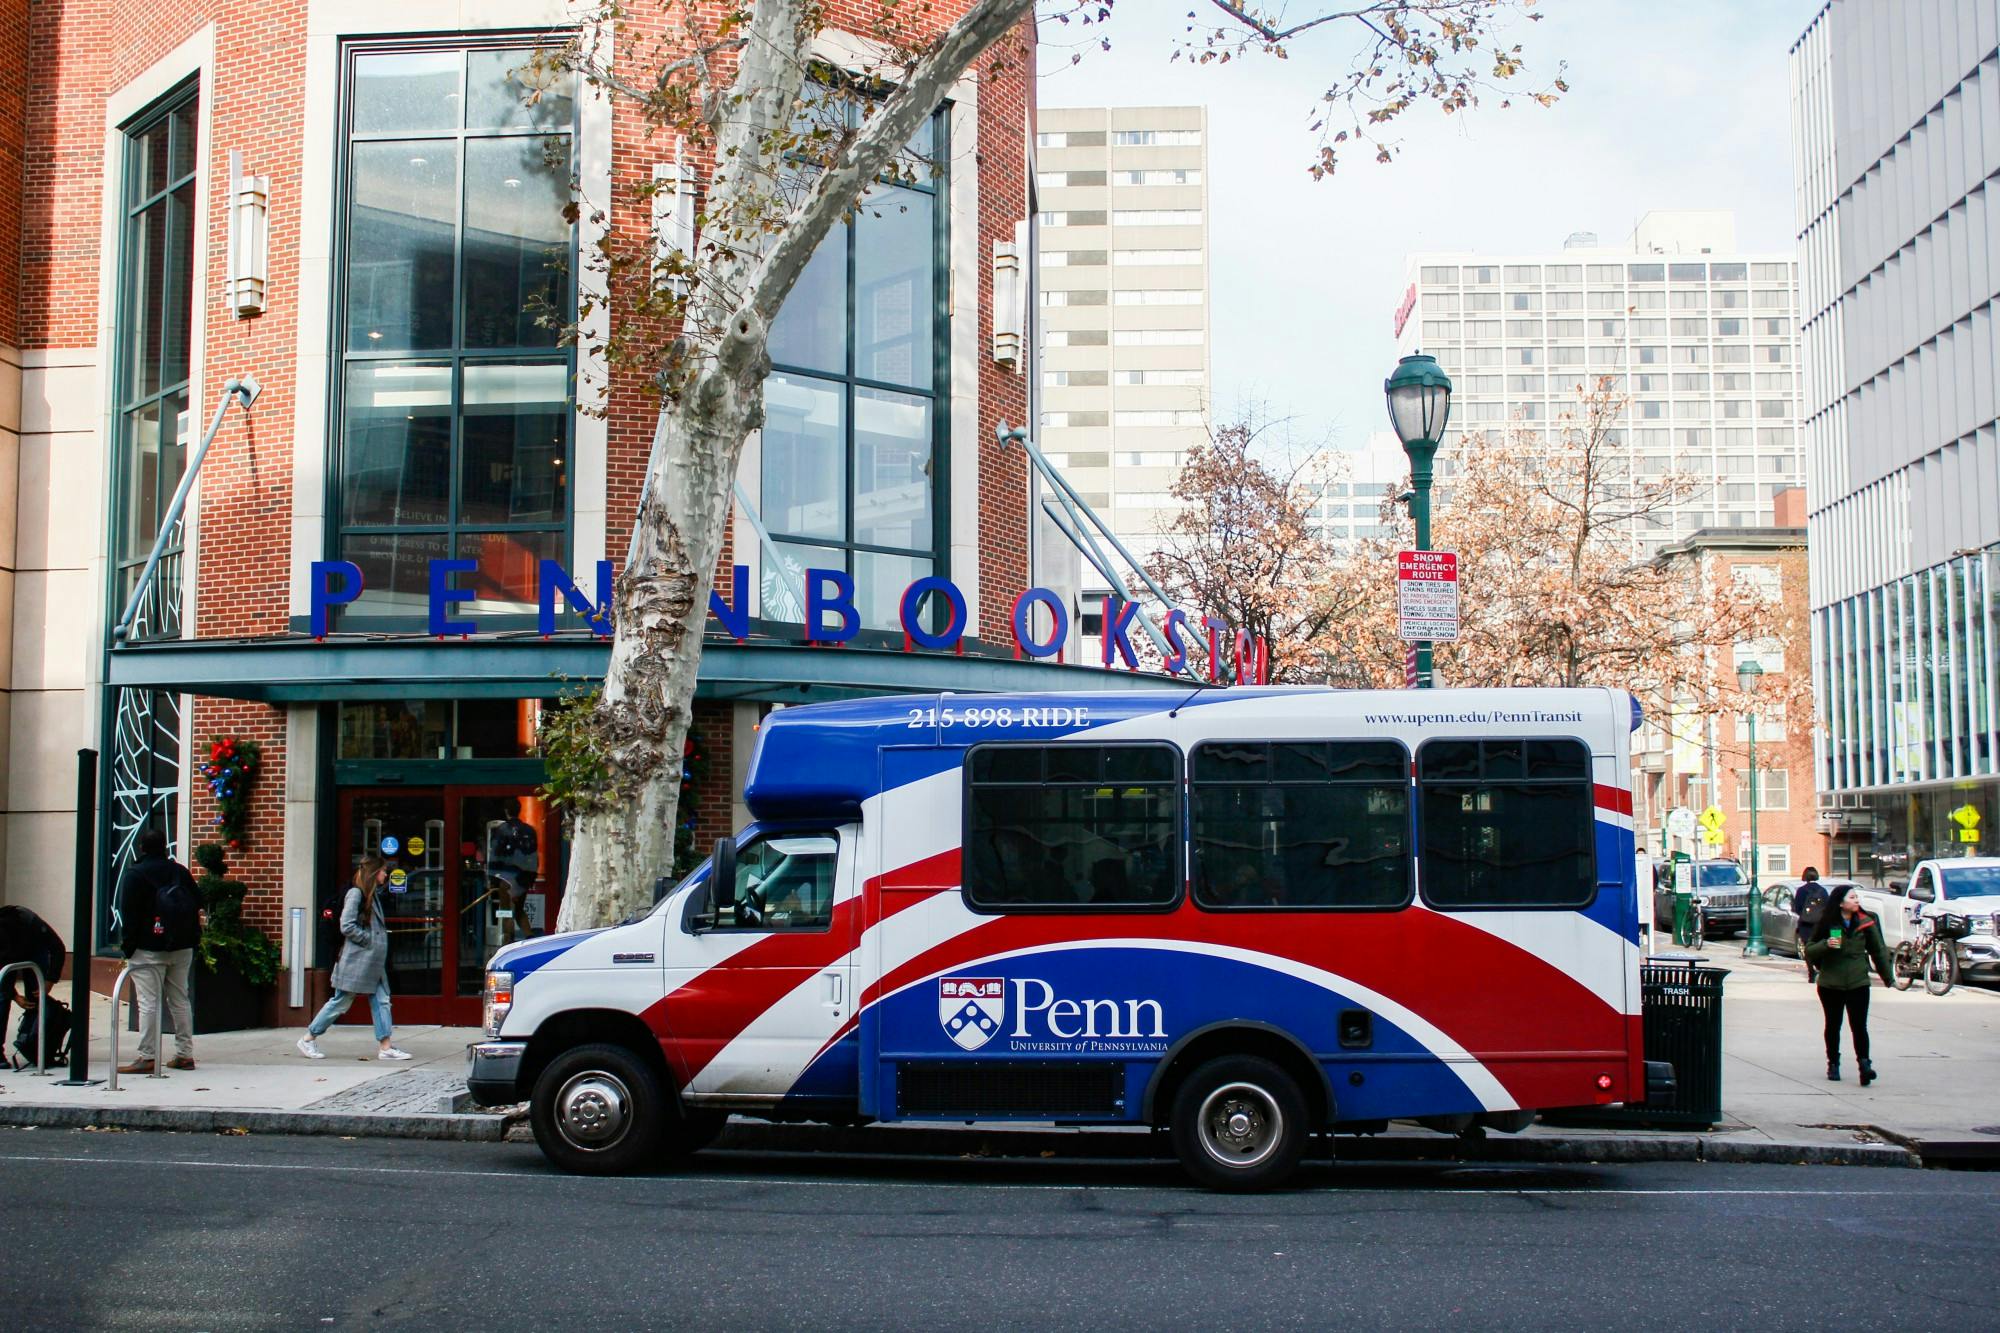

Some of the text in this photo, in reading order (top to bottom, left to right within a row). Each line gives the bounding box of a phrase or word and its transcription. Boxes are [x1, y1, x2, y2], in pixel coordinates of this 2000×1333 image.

[1413, 553, 1443, 562] SNOW
[1399, 562, 1455, 571] EMERGENCY
[1412, 571, 1444, 579] ROUTE
[908, 707, 1090, 728] 215-898-RIDE
[1364, 710, 1583, 727] www.upenn.edu/PennTransit
[1663, 987, 1690, 996] TRASH
[1010, 978, 1168, 1038] Penn
[1010, 1041, 1169, 1053] UNIVERSITY of PENNSYLVANIA
